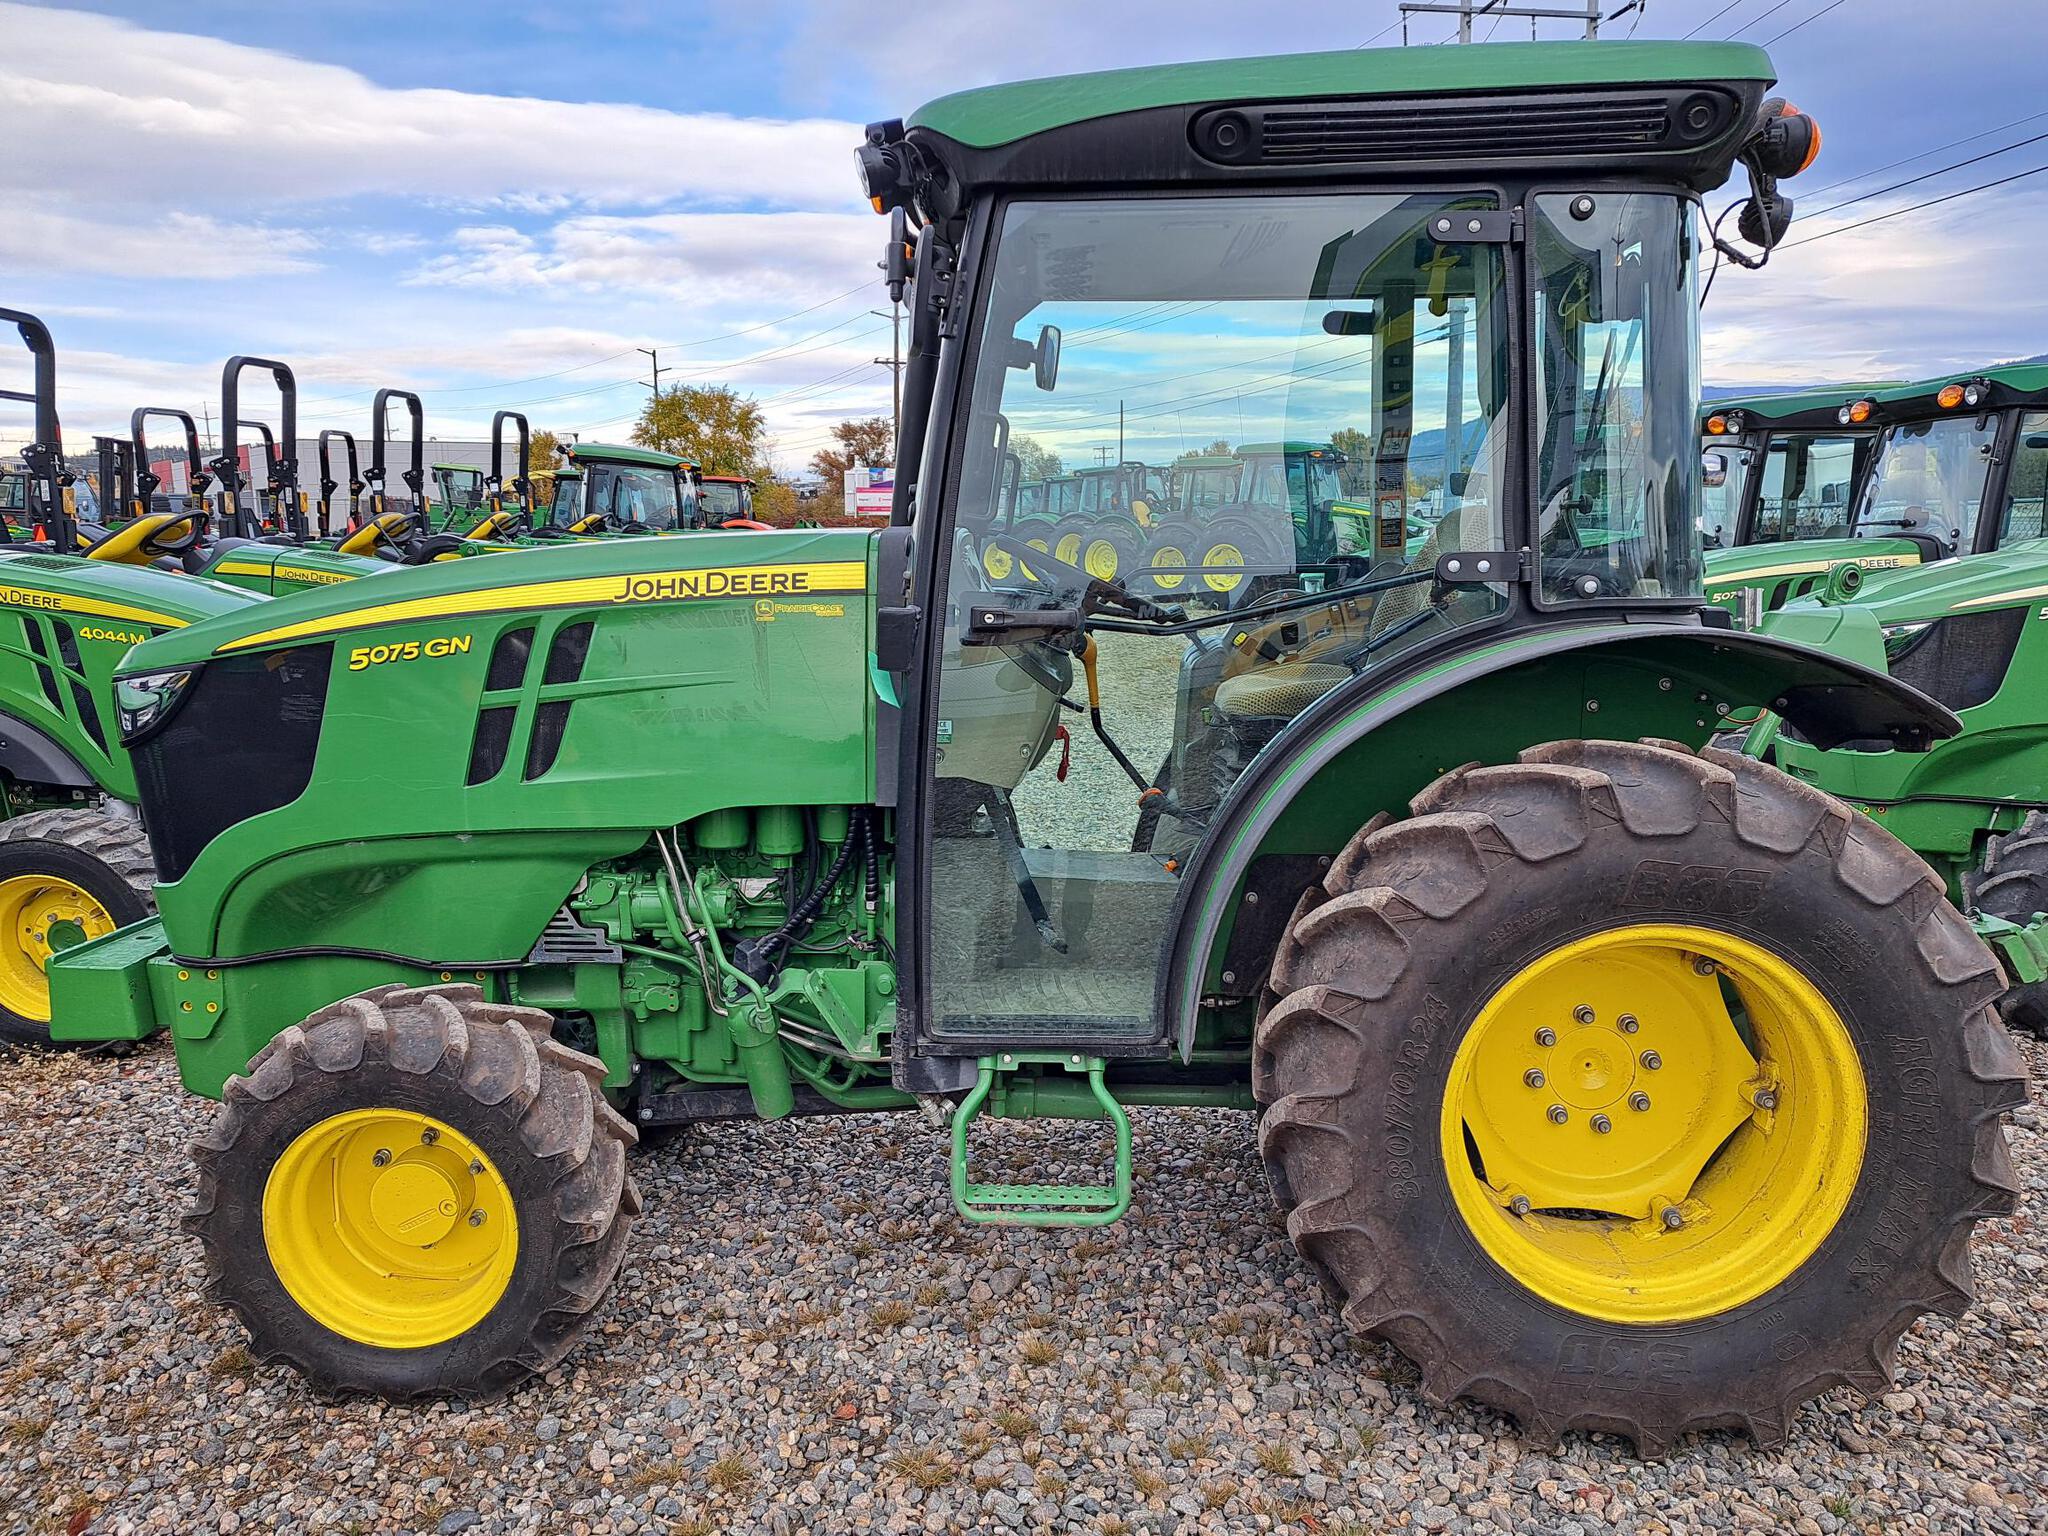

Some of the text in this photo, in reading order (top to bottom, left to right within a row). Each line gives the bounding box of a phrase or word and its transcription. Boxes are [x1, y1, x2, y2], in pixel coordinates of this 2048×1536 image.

[1859, 558, 1900, 569] DEERE
[281, 569, 309, 581] JOHN
[615, 572, 809, 601] JOHN DEERE
[10, 590, 62, 609] DEERE
[1712, 592, 1737, 603] 507
[348, 635, 472, 671] 5075 GN
